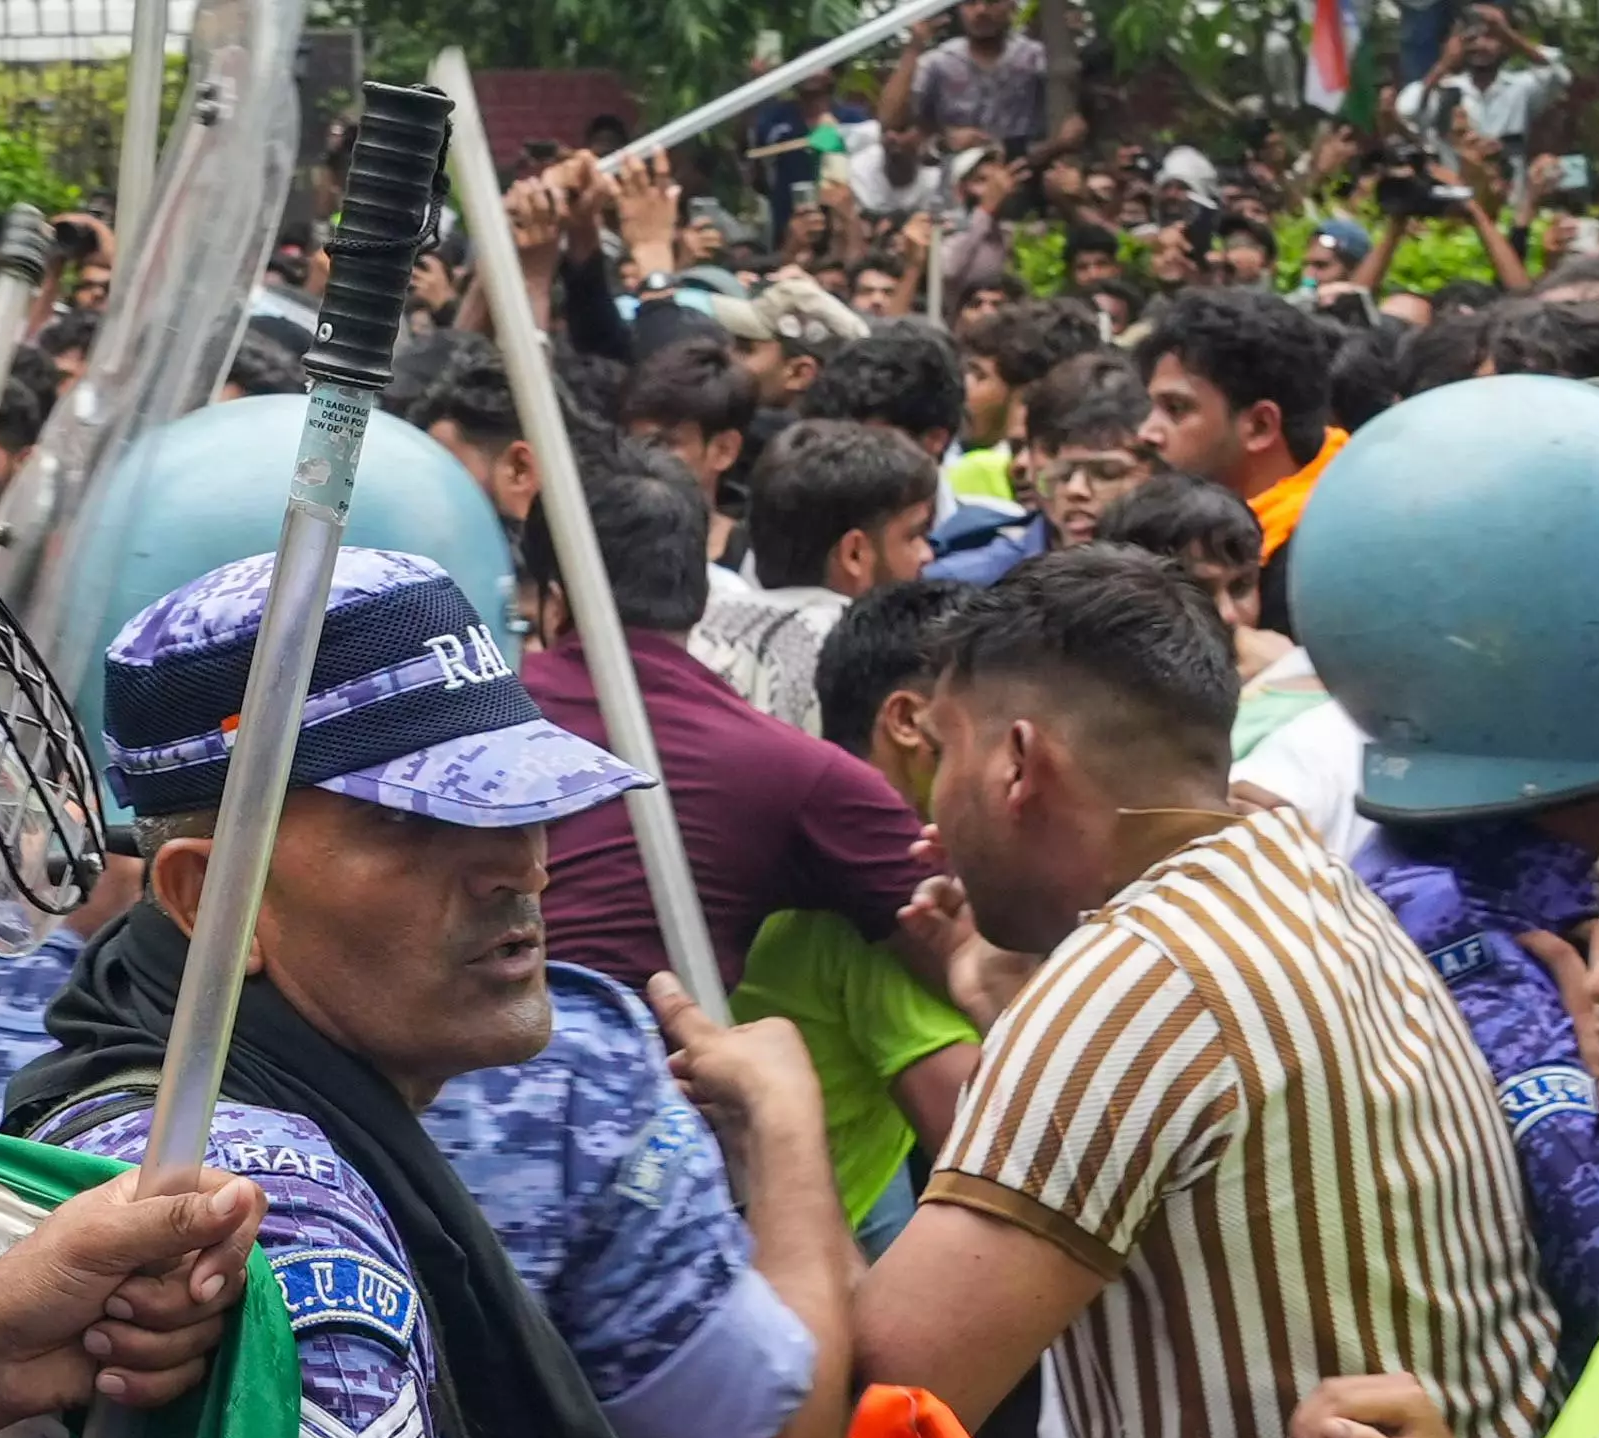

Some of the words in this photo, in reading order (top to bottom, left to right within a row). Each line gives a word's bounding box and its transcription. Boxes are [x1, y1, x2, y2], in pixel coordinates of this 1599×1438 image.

[322, 411, 349, 424] DELHI
[237, 1142, 336, 1183] RAF
[274, 1262, 404, 1317] र.ए.एफ
